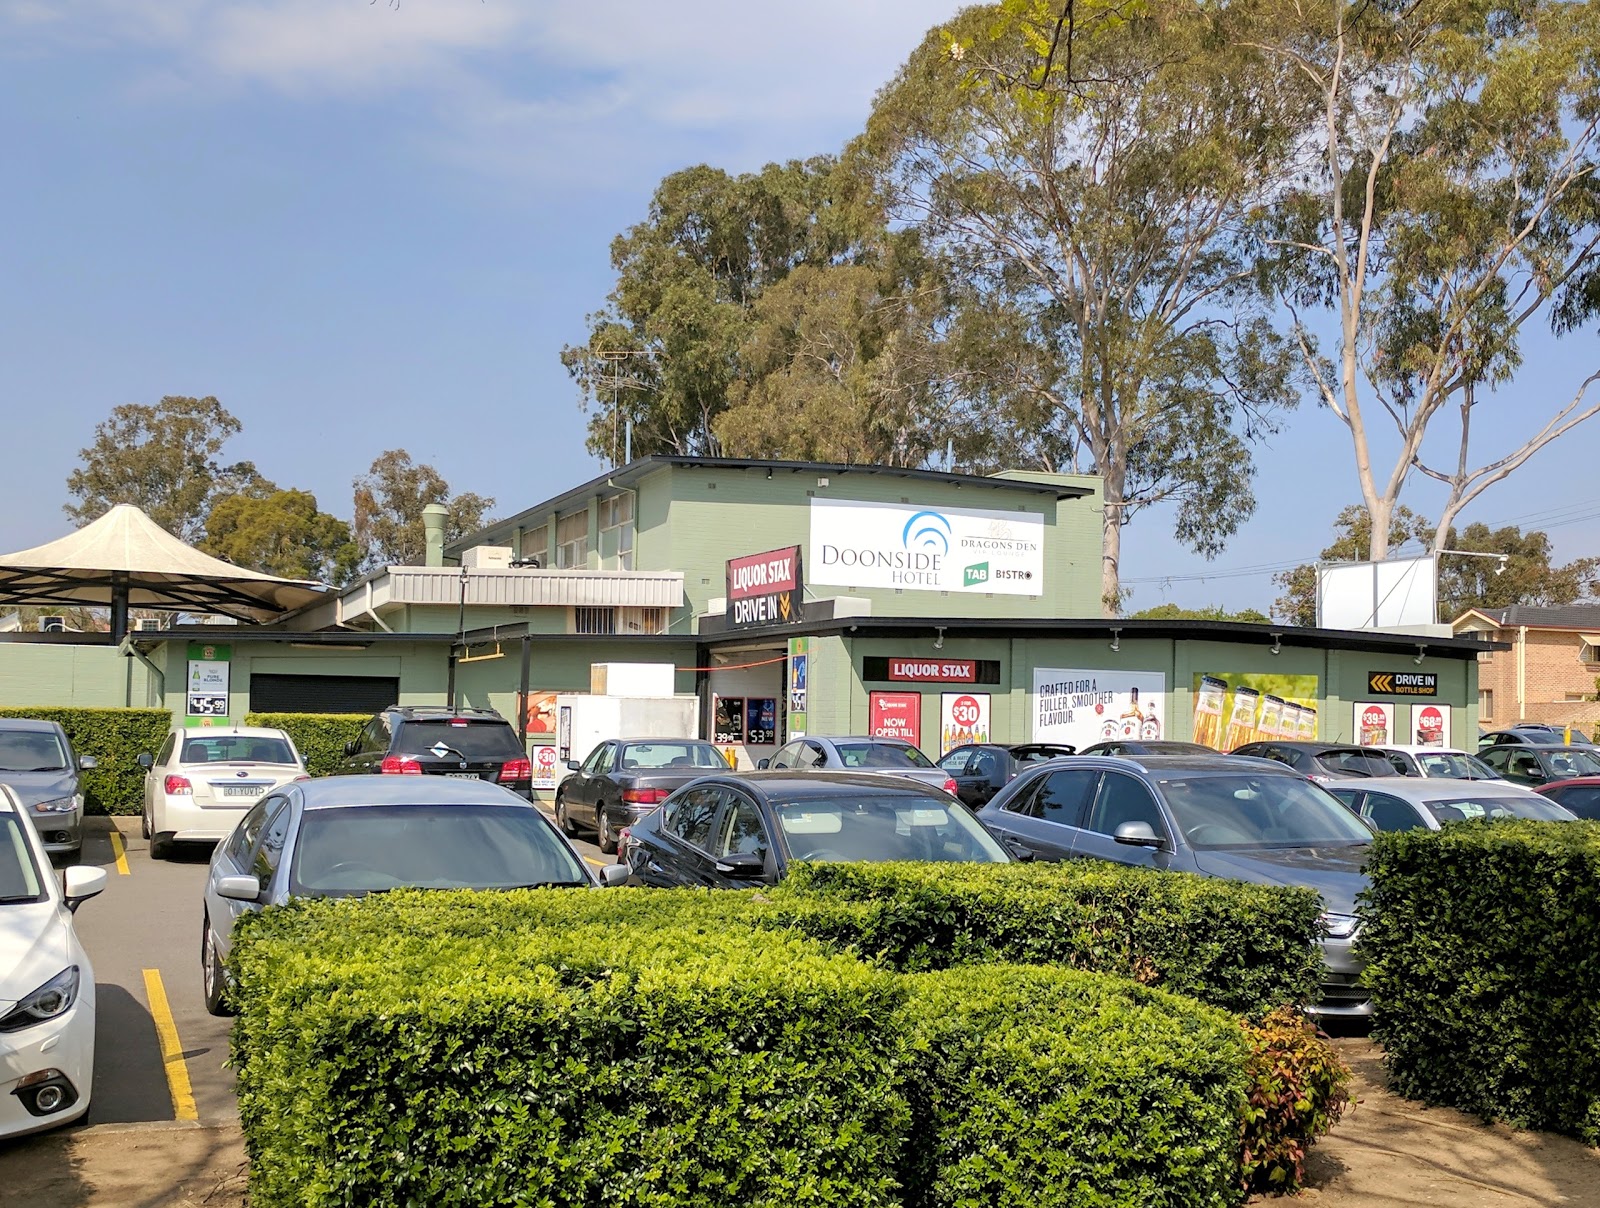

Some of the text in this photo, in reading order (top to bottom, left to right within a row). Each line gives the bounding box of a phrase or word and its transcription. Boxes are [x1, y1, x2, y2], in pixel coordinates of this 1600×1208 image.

[961, 539, 1037, 551] DRAGONS DEN
[822, 544, 941, 570] DOONSIDE
[733, 557, 791, 592] LIQUOR STAX
[892, 571, 941, 585] HOTEL
[965, 568, 987, 580] TAB
[995, 569, 1033, 580] BISTRO
[734, 595, 778, 624] DRIVE IN
[894, 663, 971, 678] LIQUOR STAX
[1395, 674, 1435, 686] DRIVE IN
[1040, 678, 1097, 698] CRAFTED FOR A
[1395, 686, 1418, 694] BOTTLE
[1040, 690, 1113, 712] FULLER, SMOOTHER
[953, 705, 978, 722] $30
[883, 718, 907, 727] NOW
[875, 727, 914, 737] OPEN TILL
[538, 752, 556, 760] $30
